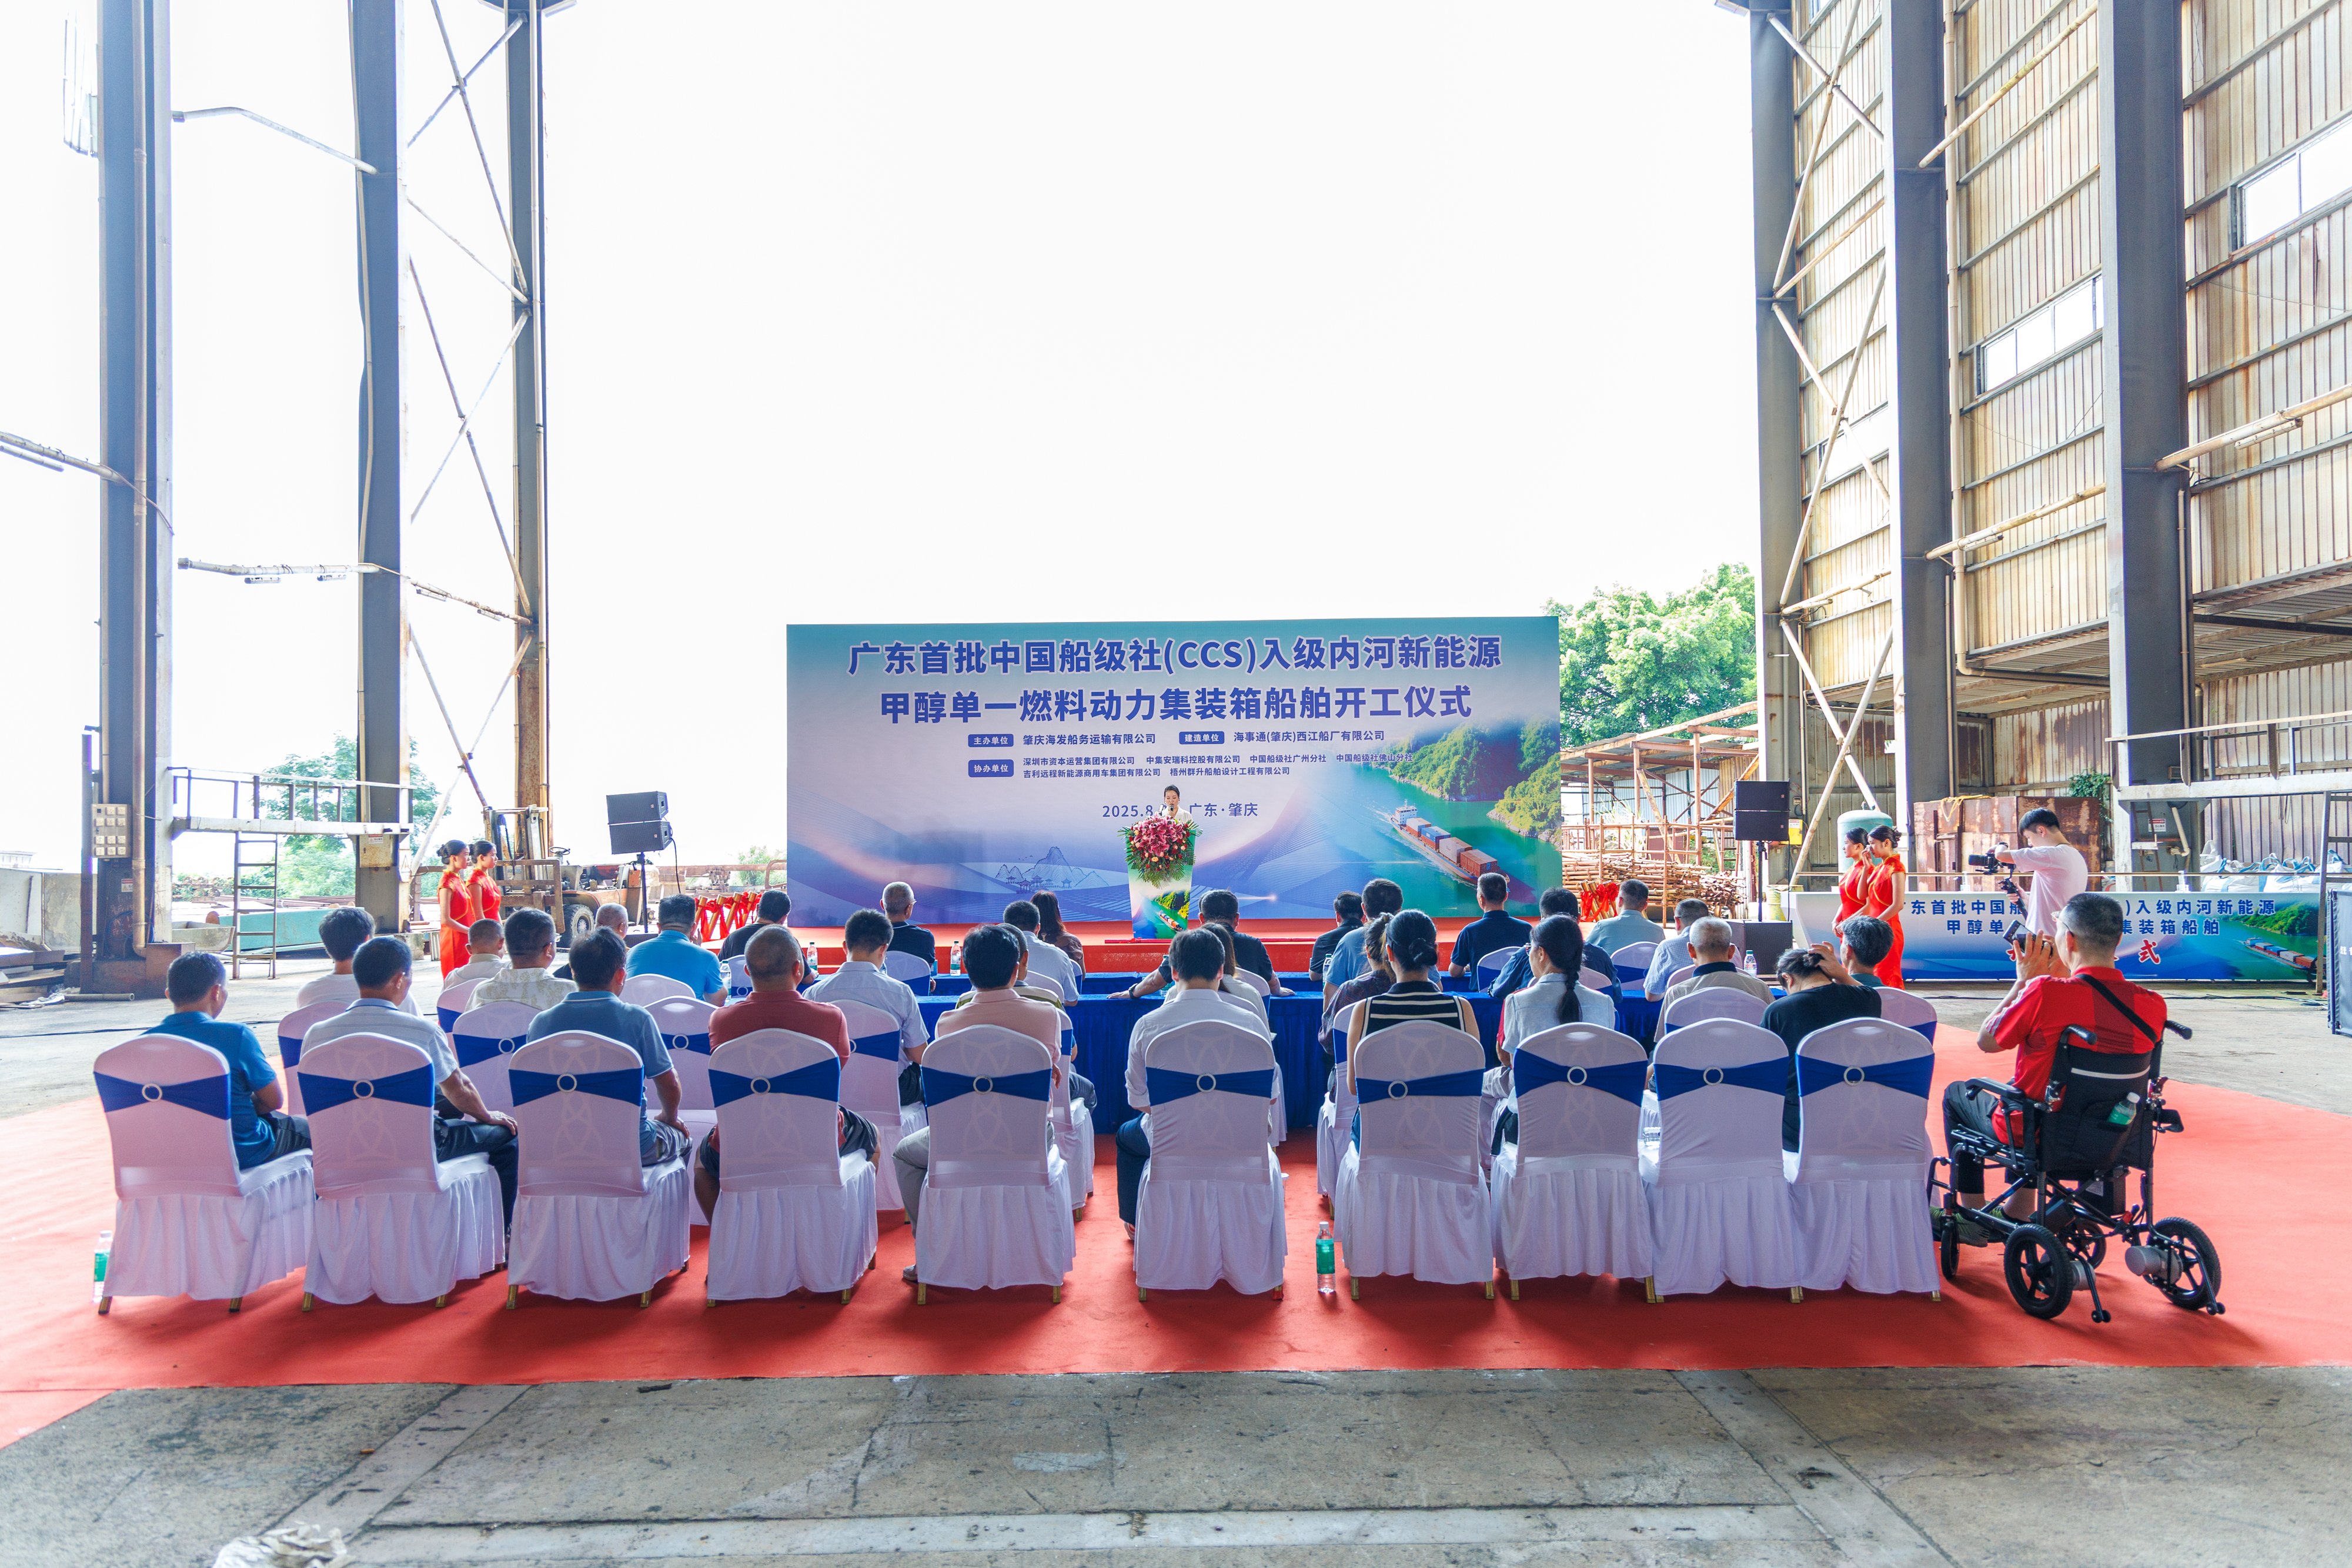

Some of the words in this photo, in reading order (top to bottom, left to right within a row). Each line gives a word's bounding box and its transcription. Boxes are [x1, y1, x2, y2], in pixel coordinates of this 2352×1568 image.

[848, 636, 1502, 676] 广东首批中国船级社(CCS)入级内河新能源
[881, 685, 1472, 724] 甲醇单一燃料动力集装箱船舶开工仪式
[973, 736, 1008, 745] 主办单位
[1023, 733, 1156, 745] 肇庆海发船务运输有限公司
[1184, 734, 1220, 743] 建造单位
[1234, 730, 1385, 743] 海事通(肇庆)西江船厂有限公司
[1023, 756, 1135, 766] 深圳市资本运营集团有限公司
[1146, 755, 1240, 764] 中集安瑞科控股有限公司
[1250, 754, 1327, 764] 中国船级社广州分社
[1336, 753, 1413, 763] 中国船级社佛山分社
[973, 764, 1008, 773] 协办单位
[1023, 768, 1161, 778] 吉利远程新能源商用车集团有限公司
[1170, 767, 1290, 776] 梧州群升船舶设计工程有限公司
[1903, 900, 2023, 915] 东首批中国
